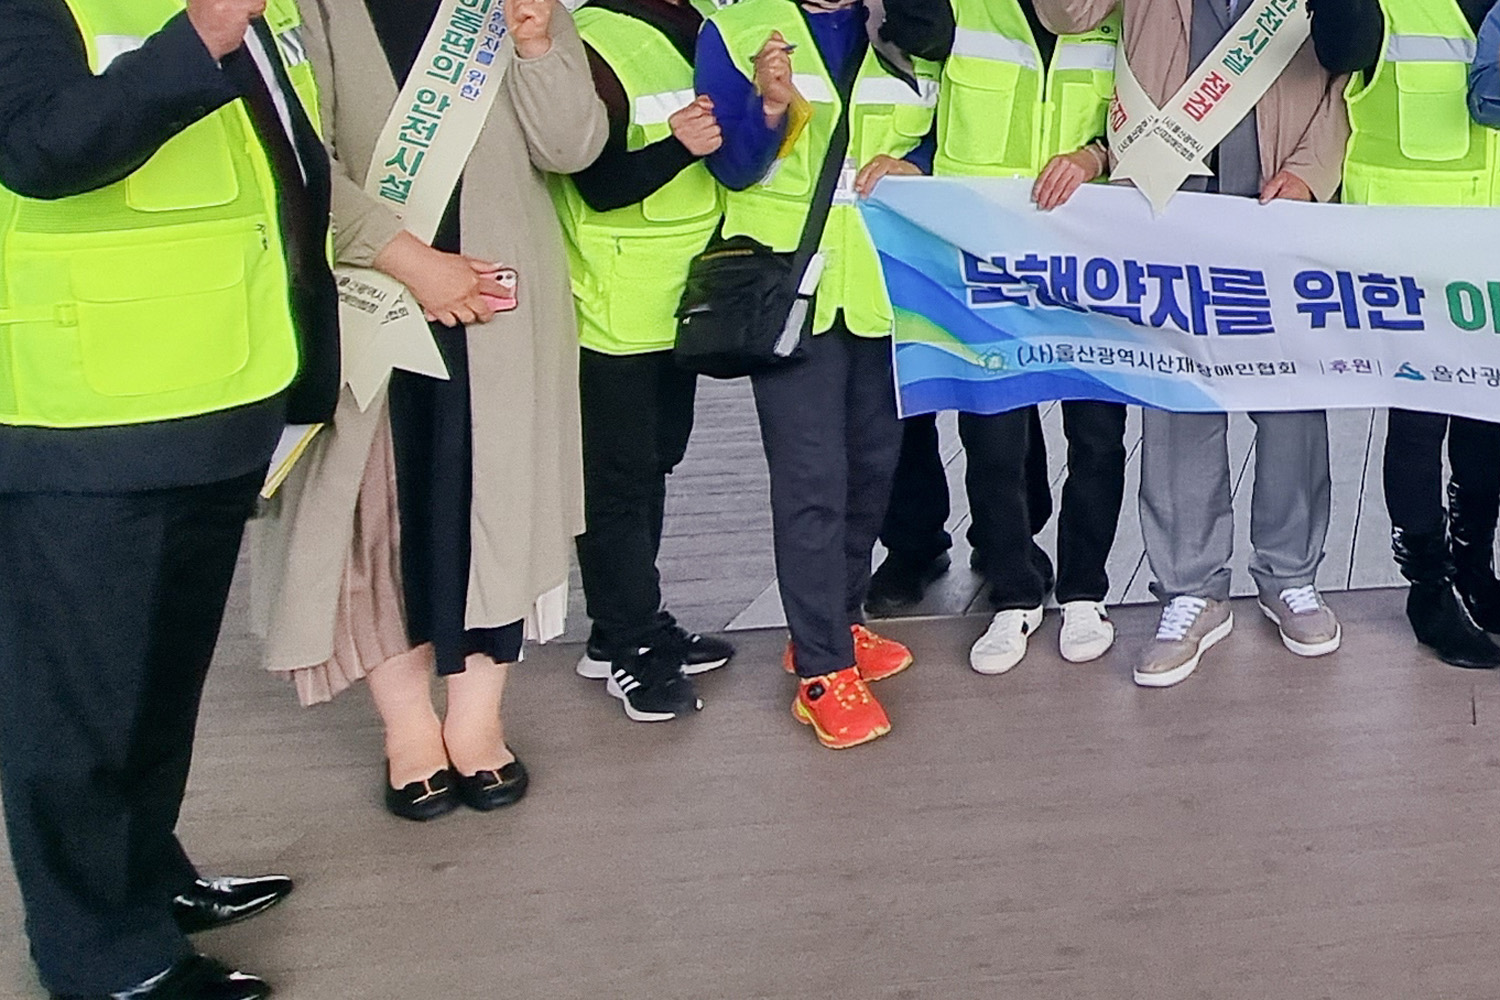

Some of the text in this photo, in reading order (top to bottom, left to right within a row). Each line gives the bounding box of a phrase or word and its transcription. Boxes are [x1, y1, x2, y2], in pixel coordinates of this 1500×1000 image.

[459, 68, 487, 101] 위한
[1182, 70, 1232, 122] 점검
[379, 86, 450, 205] 안전시설
[1293, 269, 1426, 331] 위한
[1329, 358, 1373, 375] 후원
